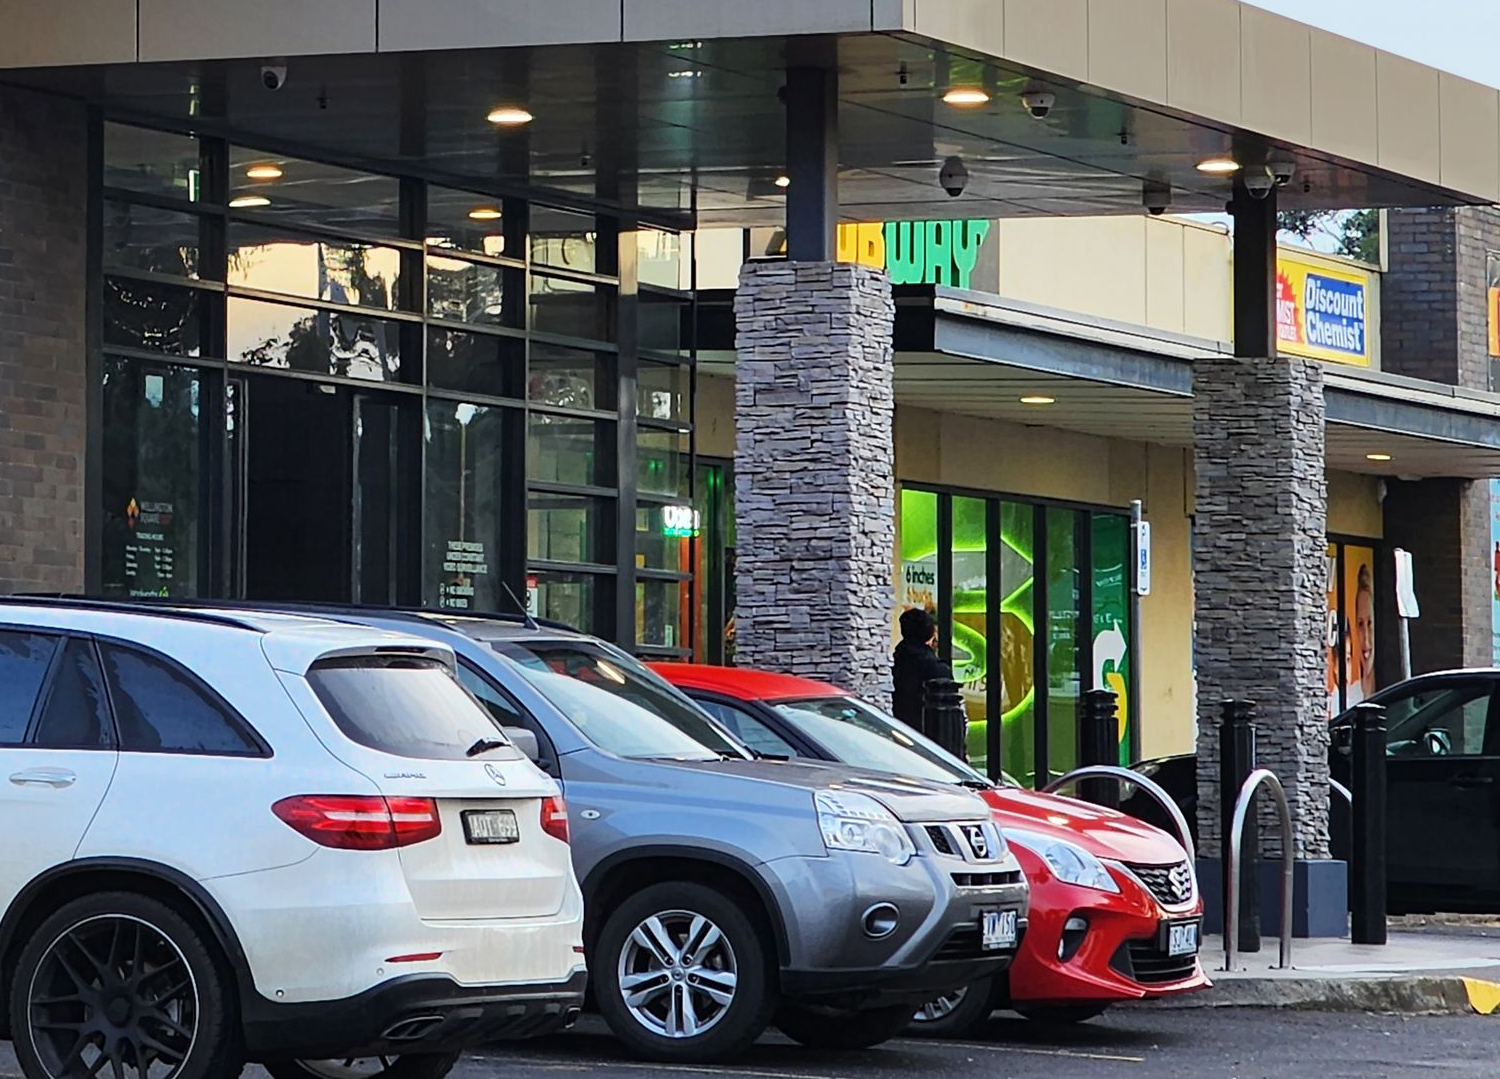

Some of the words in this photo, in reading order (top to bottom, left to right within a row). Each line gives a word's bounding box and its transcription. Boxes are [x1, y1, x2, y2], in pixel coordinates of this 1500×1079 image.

[836, 219, 990, 292] UBWAY
[1306, 277, 1364, 320] Discount
[1307, 310, 1362, 352] Chemist
[912, 566, 935, 585] inches
